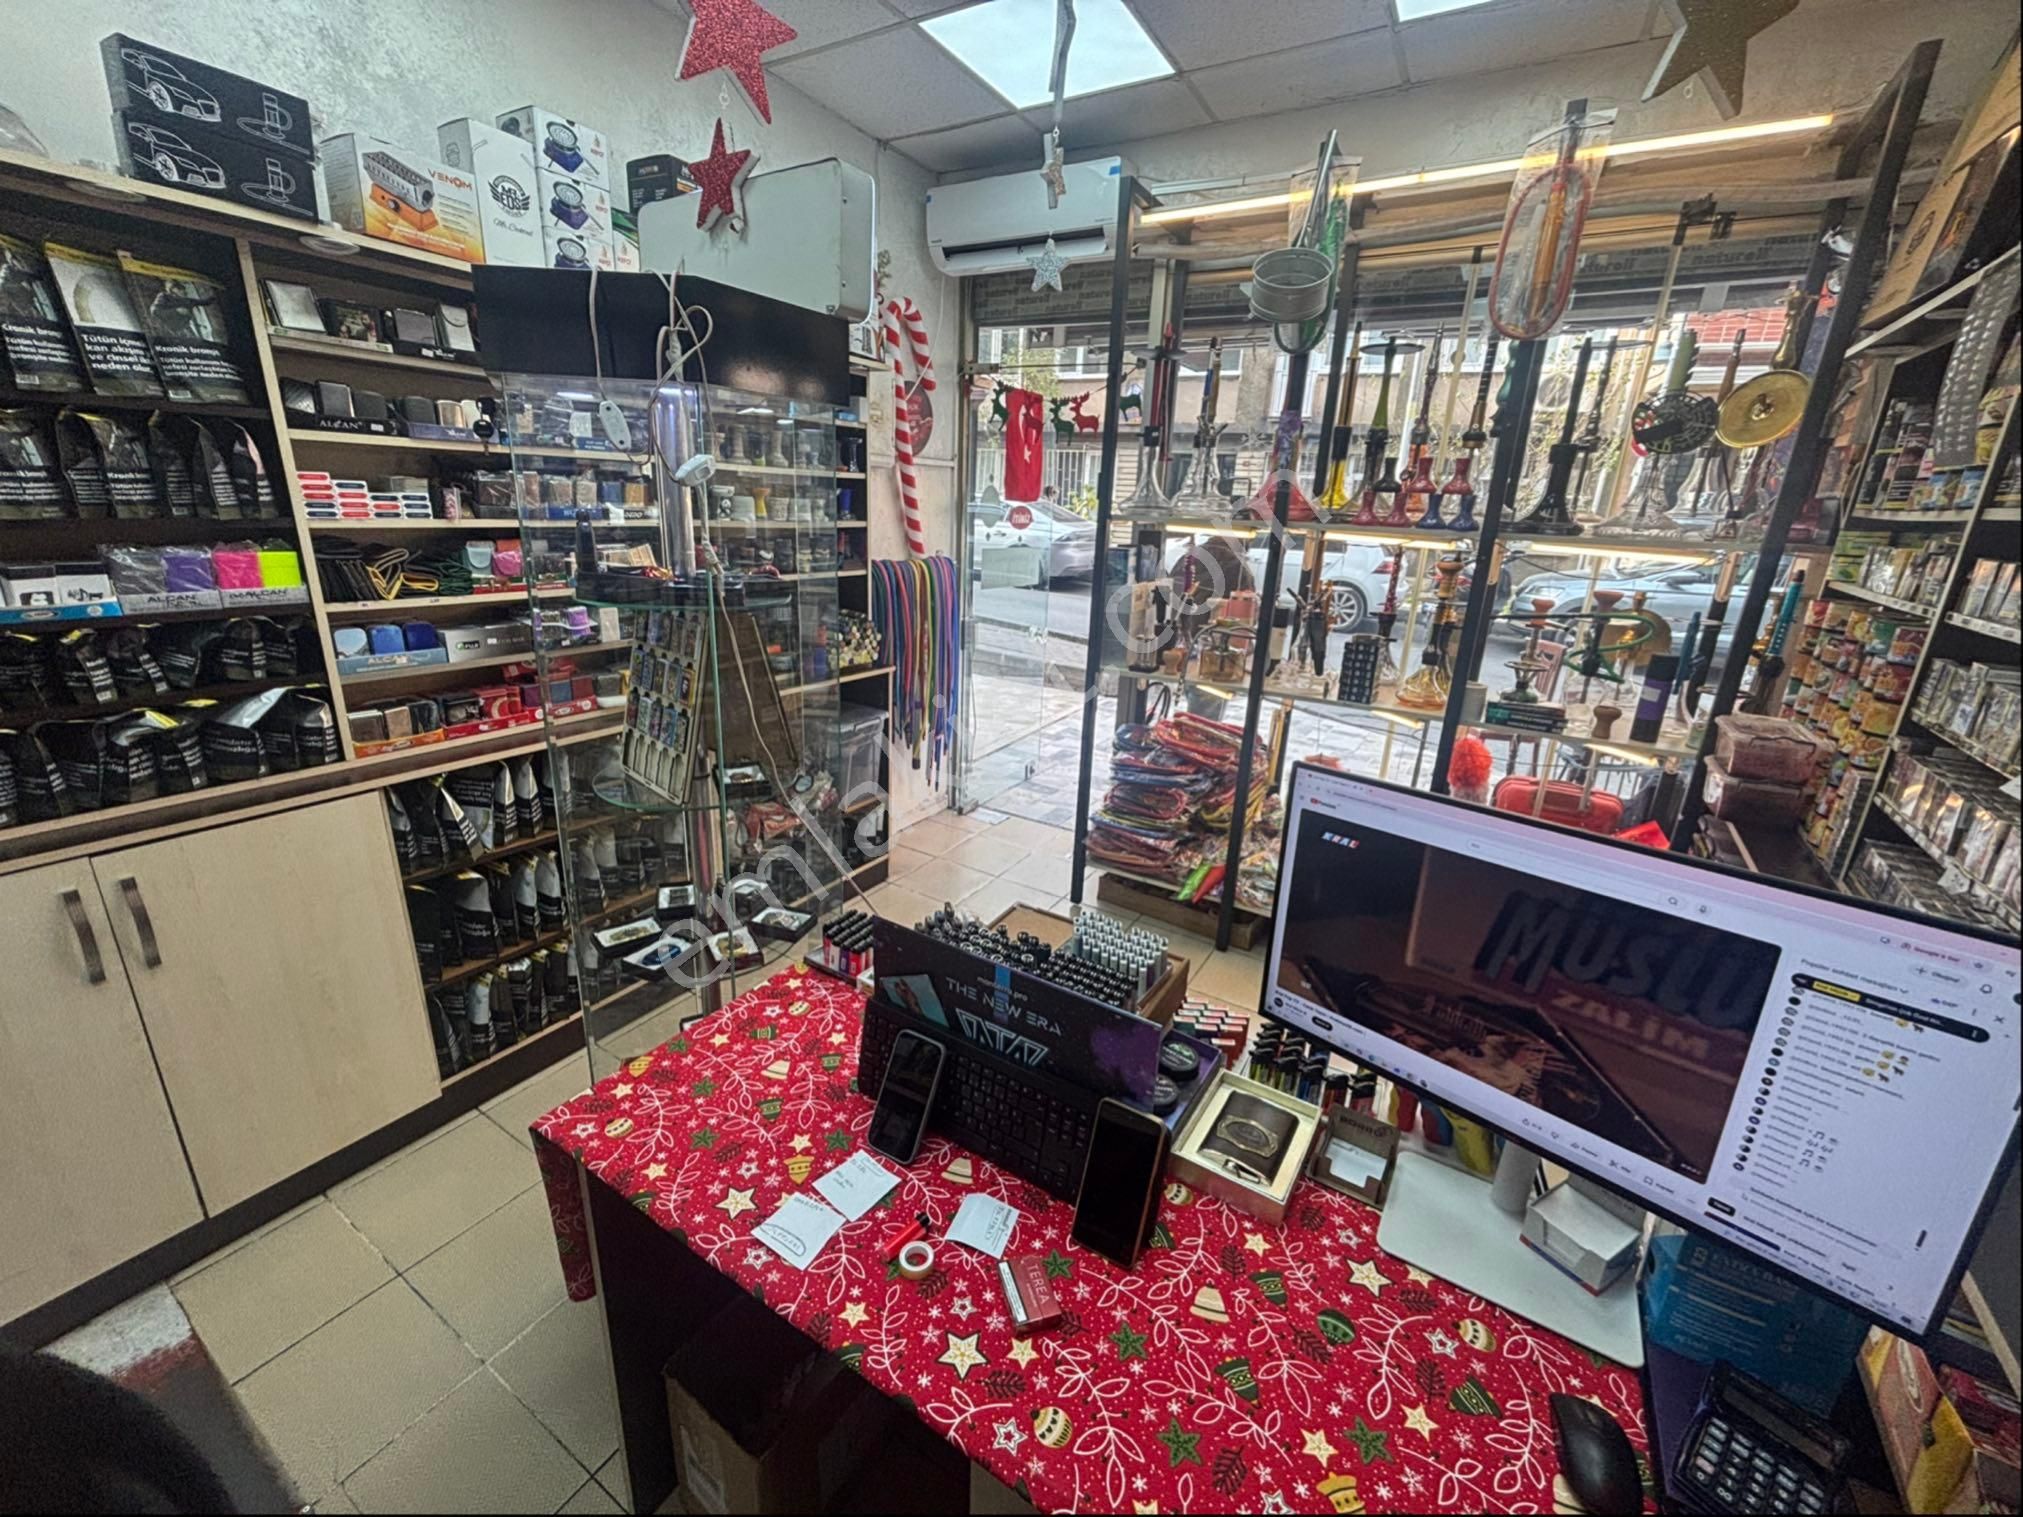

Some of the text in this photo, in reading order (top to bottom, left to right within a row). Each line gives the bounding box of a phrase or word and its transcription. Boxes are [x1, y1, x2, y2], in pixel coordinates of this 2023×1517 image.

[428, 168, 473, 191] VENOM
[82, 334, 117, 344] Tütün
[85, 343, 109, 352] kan
[155, 345, 189, 354] Kronik
[88, 353, 104, 361] ve
[106, 354, 138, 362] cinsel
[91, 362, 130, 371] neden
[319, 419, 357, 430] ALCAN
[1321, 831, 1360, 849] KRAL
[945, 976, 977, 1000] THE
[982, 992, 1022, 1018] NEW
[1026, 1010, 1062, 1036] ERA
[1027, 1263, 1050, 1304] TEREA
